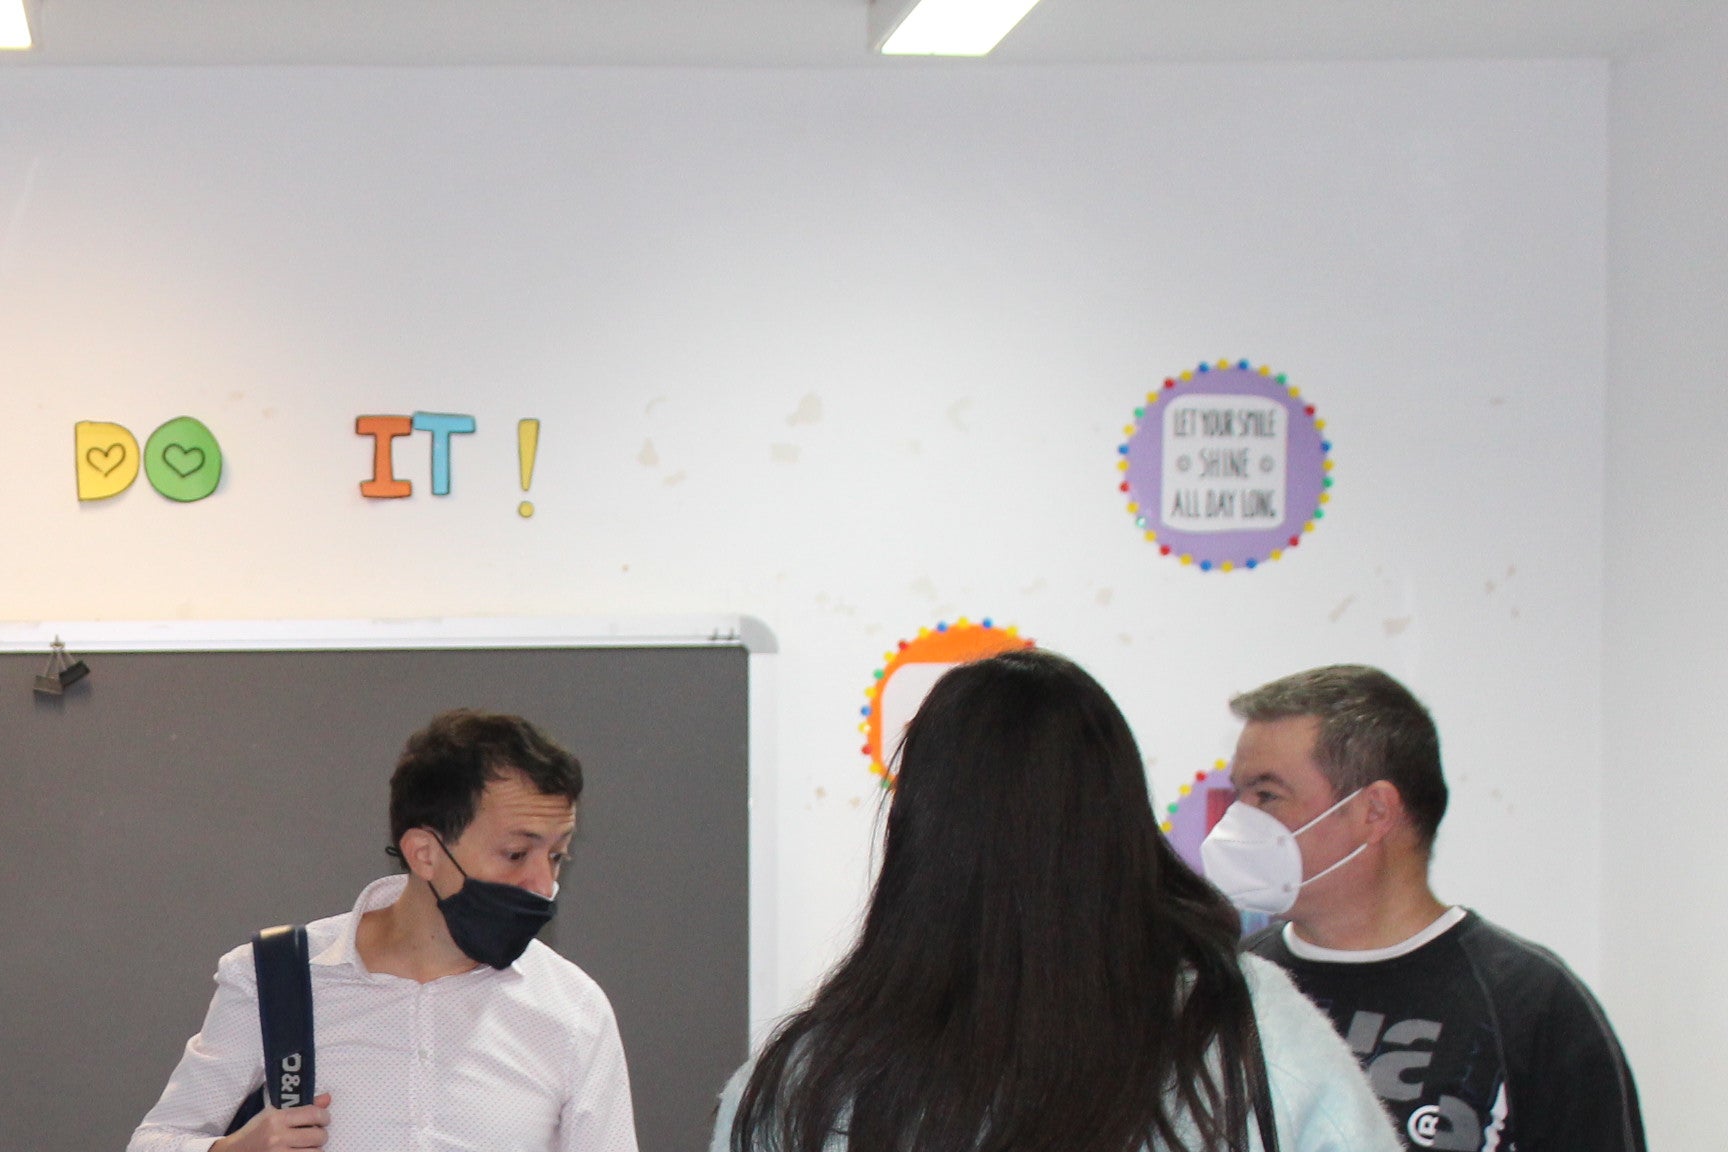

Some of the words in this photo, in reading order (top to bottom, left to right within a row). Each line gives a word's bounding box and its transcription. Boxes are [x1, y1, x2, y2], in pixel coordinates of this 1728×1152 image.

[1174, 408, 1196, 436] LET
[1199, 408, 1235, 436] YOUR
[1237, 408, 1277, 436] SMILE
[75, 415, 223, 502] DO
[355, 411, 476, 498] IT
[1198, 446, 1250, 477] SHINE
[1171, 488, 1201, 517] ALL
[1205, 488, 1237, 517] DAY
[1239, 488, 1277, 518] LONG
